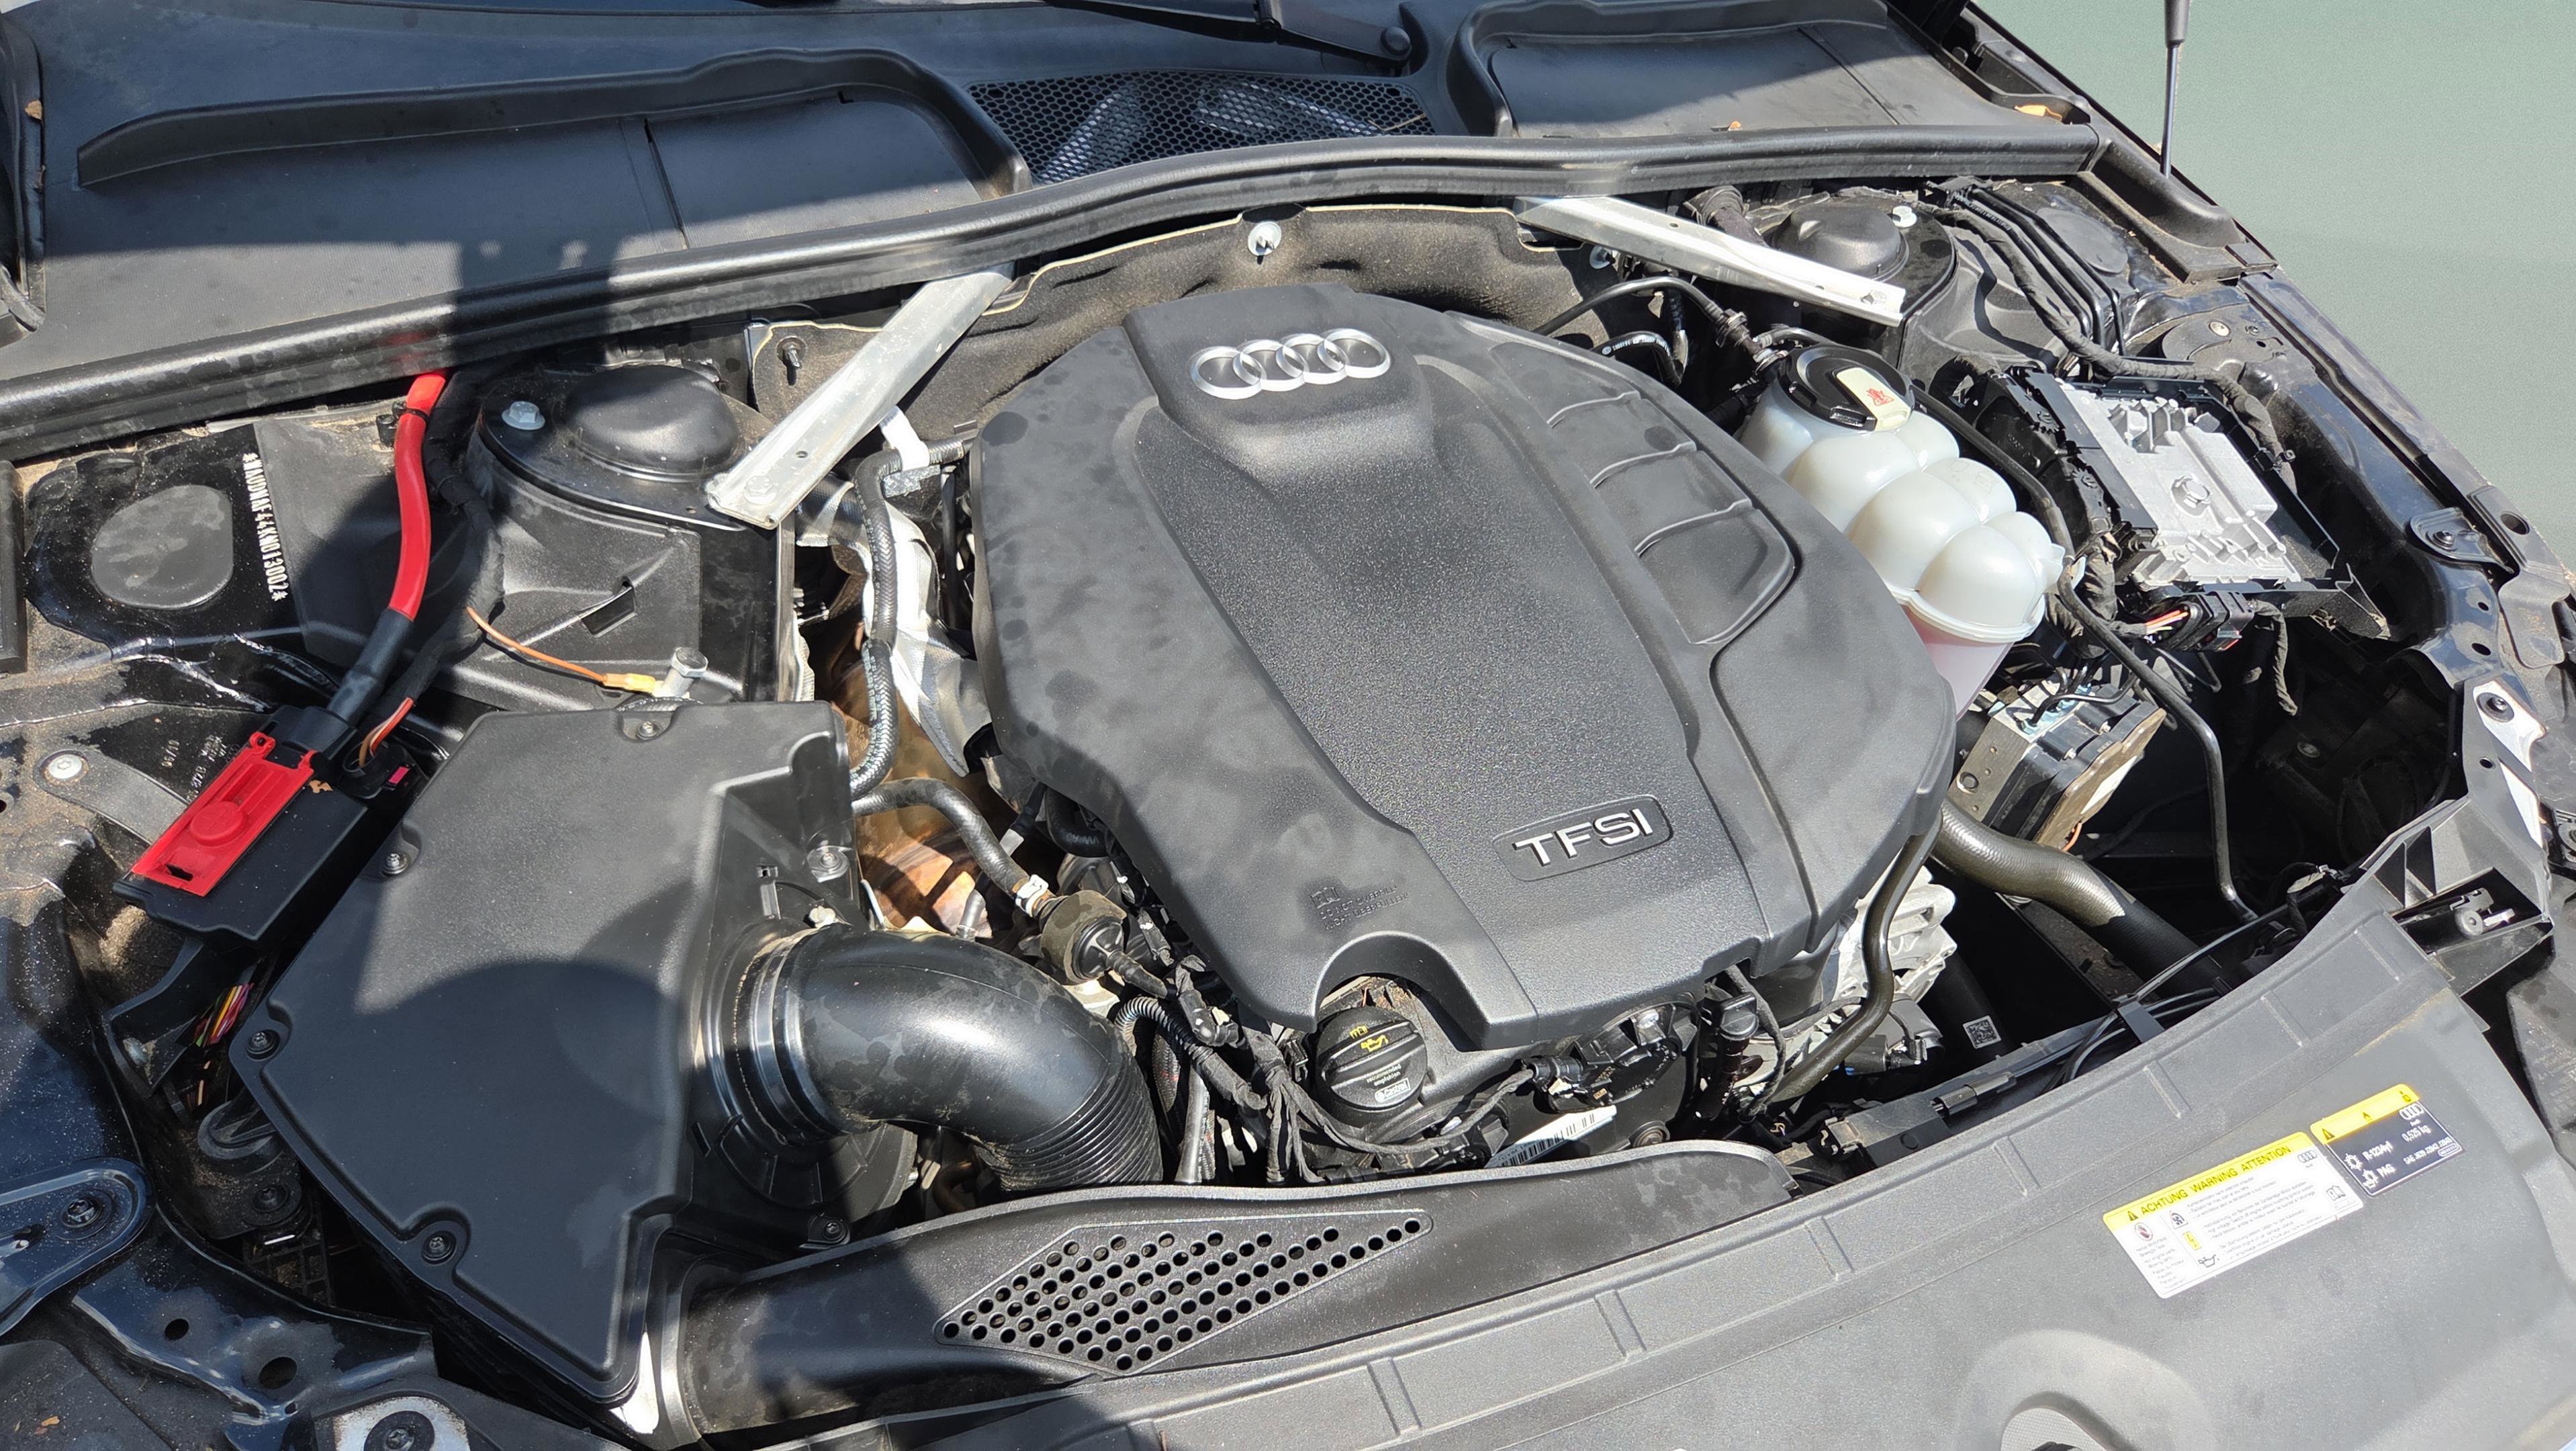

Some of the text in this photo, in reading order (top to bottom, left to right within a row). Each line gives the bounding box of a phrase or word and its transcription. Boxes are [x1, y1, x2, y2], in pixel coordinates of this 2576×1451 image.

[1513, 809, 1653, 866] TFSI
[1334, 901, 1353, 913] NOT
[1367, 1064, 1402, 1083] recommended
[1384, 1081, 1407, 1097] Castrol
[2418, 1125, 2430, 1133] kg
[2376, 1163, 2395, 1178] PAG
[2140, 1190, 2188, 1215] ACHTUNG
[2191, 1168, 2238, 1192] WARNING
[2241, 1145, 2291, 1172] ATTENTION
